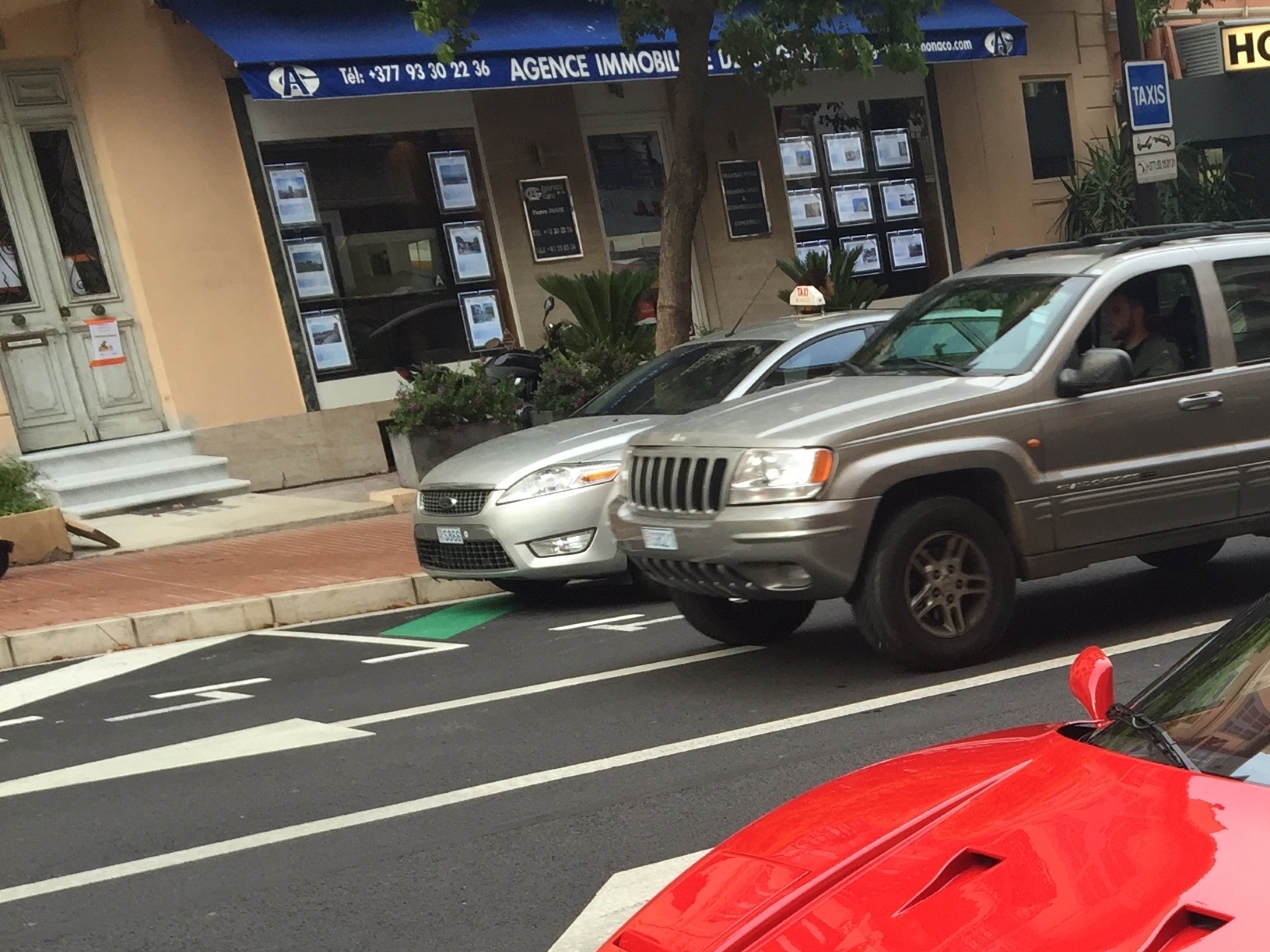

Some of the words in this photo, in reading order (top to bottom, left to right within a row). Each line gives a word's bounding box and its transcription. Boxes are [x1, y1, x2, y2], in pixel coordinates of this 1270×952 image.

[369, 65, 399, 83] +377
[405, 63, 424, 80] 93
[428, 61, 446, 80] 30
[451, 59, 470, 78] 22
[472, 60, 491, 77] 36
[510, 54, 590, 81] AGENCE
[1131, 84, 1166, 106] TAXIS
[797, 287, 809, 297] TAXI
